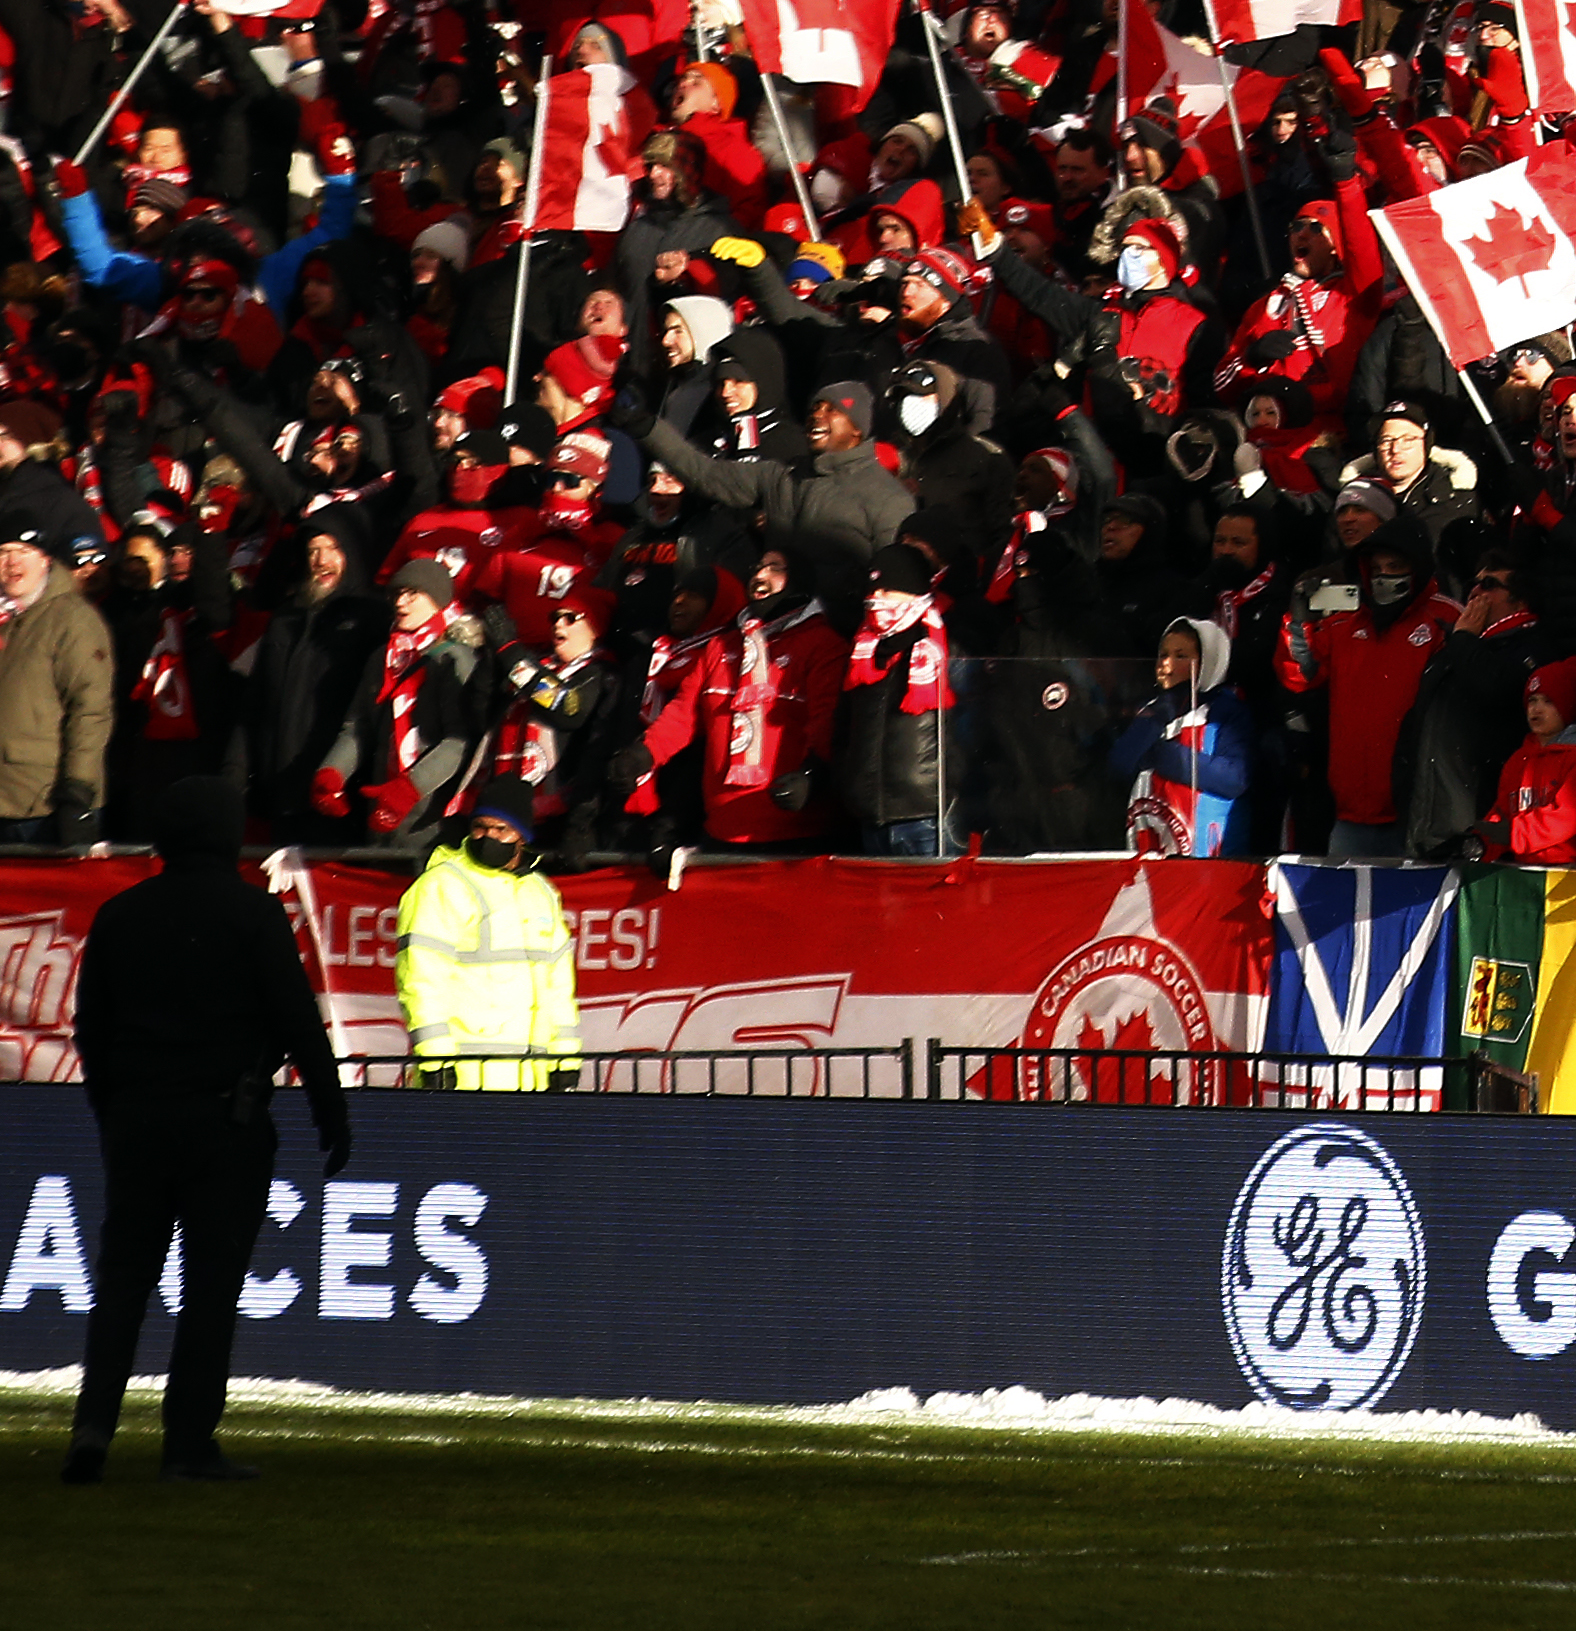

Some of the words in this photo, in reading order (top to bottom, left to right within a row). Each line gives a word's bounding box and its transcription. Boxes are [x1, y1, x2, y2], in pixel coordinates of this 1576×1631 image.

[536, 562, 575, 600] 19
[1041, 943, 1148, 1018] CANADIAN
[1150, 952, 1207, 1042] SOCCER
